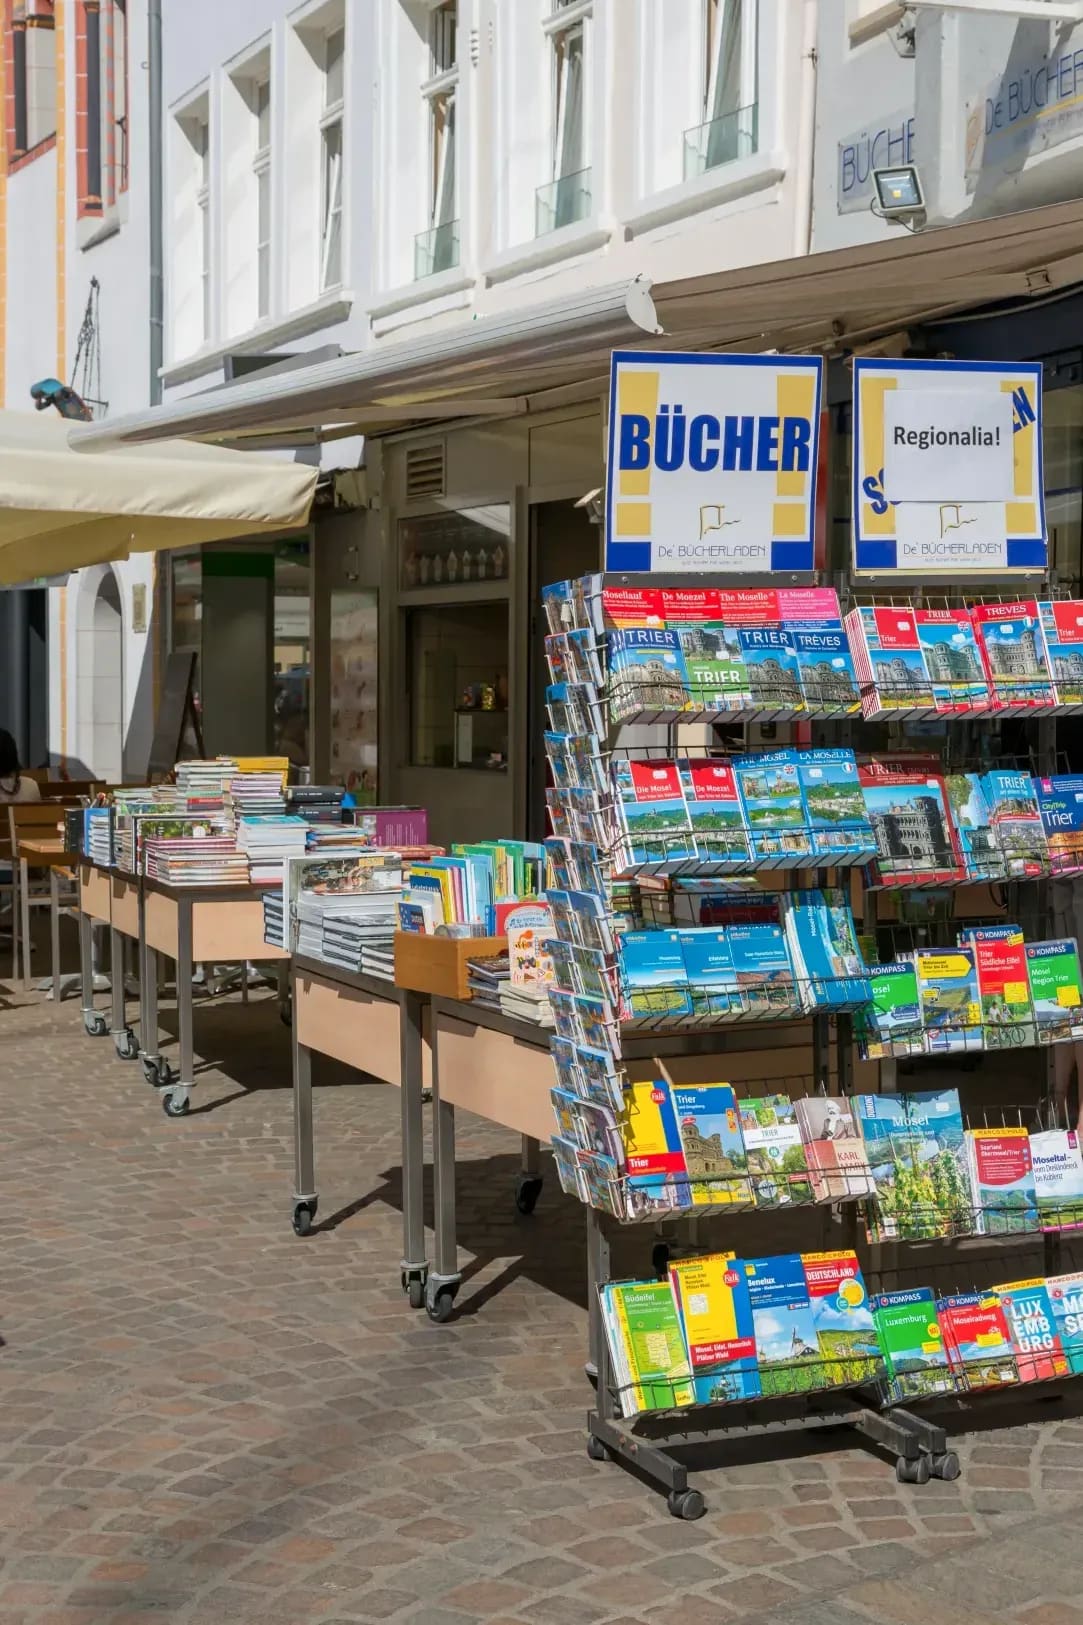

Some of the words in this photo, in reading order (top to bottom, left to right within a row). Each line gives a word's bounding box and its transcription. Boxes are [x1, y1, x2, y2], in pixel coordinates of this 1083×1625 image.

[619, 404, 811, 472] BÜCHER
[894, 426, 1000, 450] Regionalia!
[678, 543, 766, 557] BÜCHERLADEN
[921, 541, 1002, 556] BÜCHERLADEN
[662, 592, 674, 601] De
[676, 592, 706, 601] Moezel
[720, 592, 736, 602] The
[737, 592, 768, 602] Moselle
[927, 610, 952, 619] TRIER
[626, 630, 676, 645] TRIER
[742, 631, 789, 645] TRIER
[880, 635, 897, 643] Trier
[1059, 629, 1075, 637] Trier
[798, 633, 841, 647] TRÈVES
[694, 671, 741, 687] TRIER
[636, 785, 649, 794] Die
[650, 784, 672, 793] Mosel
[997, 776, 1028, 790] TRIER
[984, 929, 1015, 939] KOMPASS
[979, 950, 994, 959] Trier
[1036, 945, 1067, 957] KOMPASS
[870, 965, 906, 976] KOMPASS
[1031, 967, 1051, 977] Mosel
[1032, 976, 1055, 987] Region
[1055, 975, 1069, 983] Trier
[872, 984, 891, 995] osel
[676, 1094, 697, 1105] Trier
[892, 1115, 930, 1128] Mosel
[838, 1151, 859, 1161] KARL
[1032, 1153, 1067, 1166] Moseltal
[629, 1158, 649, 1169] Trier
[807, 1267, 856, 1281] DEUTSCHLAND
[748, 1277, 775, 1288] Benelux
[889, 1294, 921, 1305] KOMPASS
[956, 1295, 985, 1306] KOMPASS
[1012, 1299, 1045, 1320] LUX
[885, 1314, 928, 1328] Luxemburg
[1013, 1317, 1051, 1338] EMB
[1018, 1333, 1055, 1354] URG
